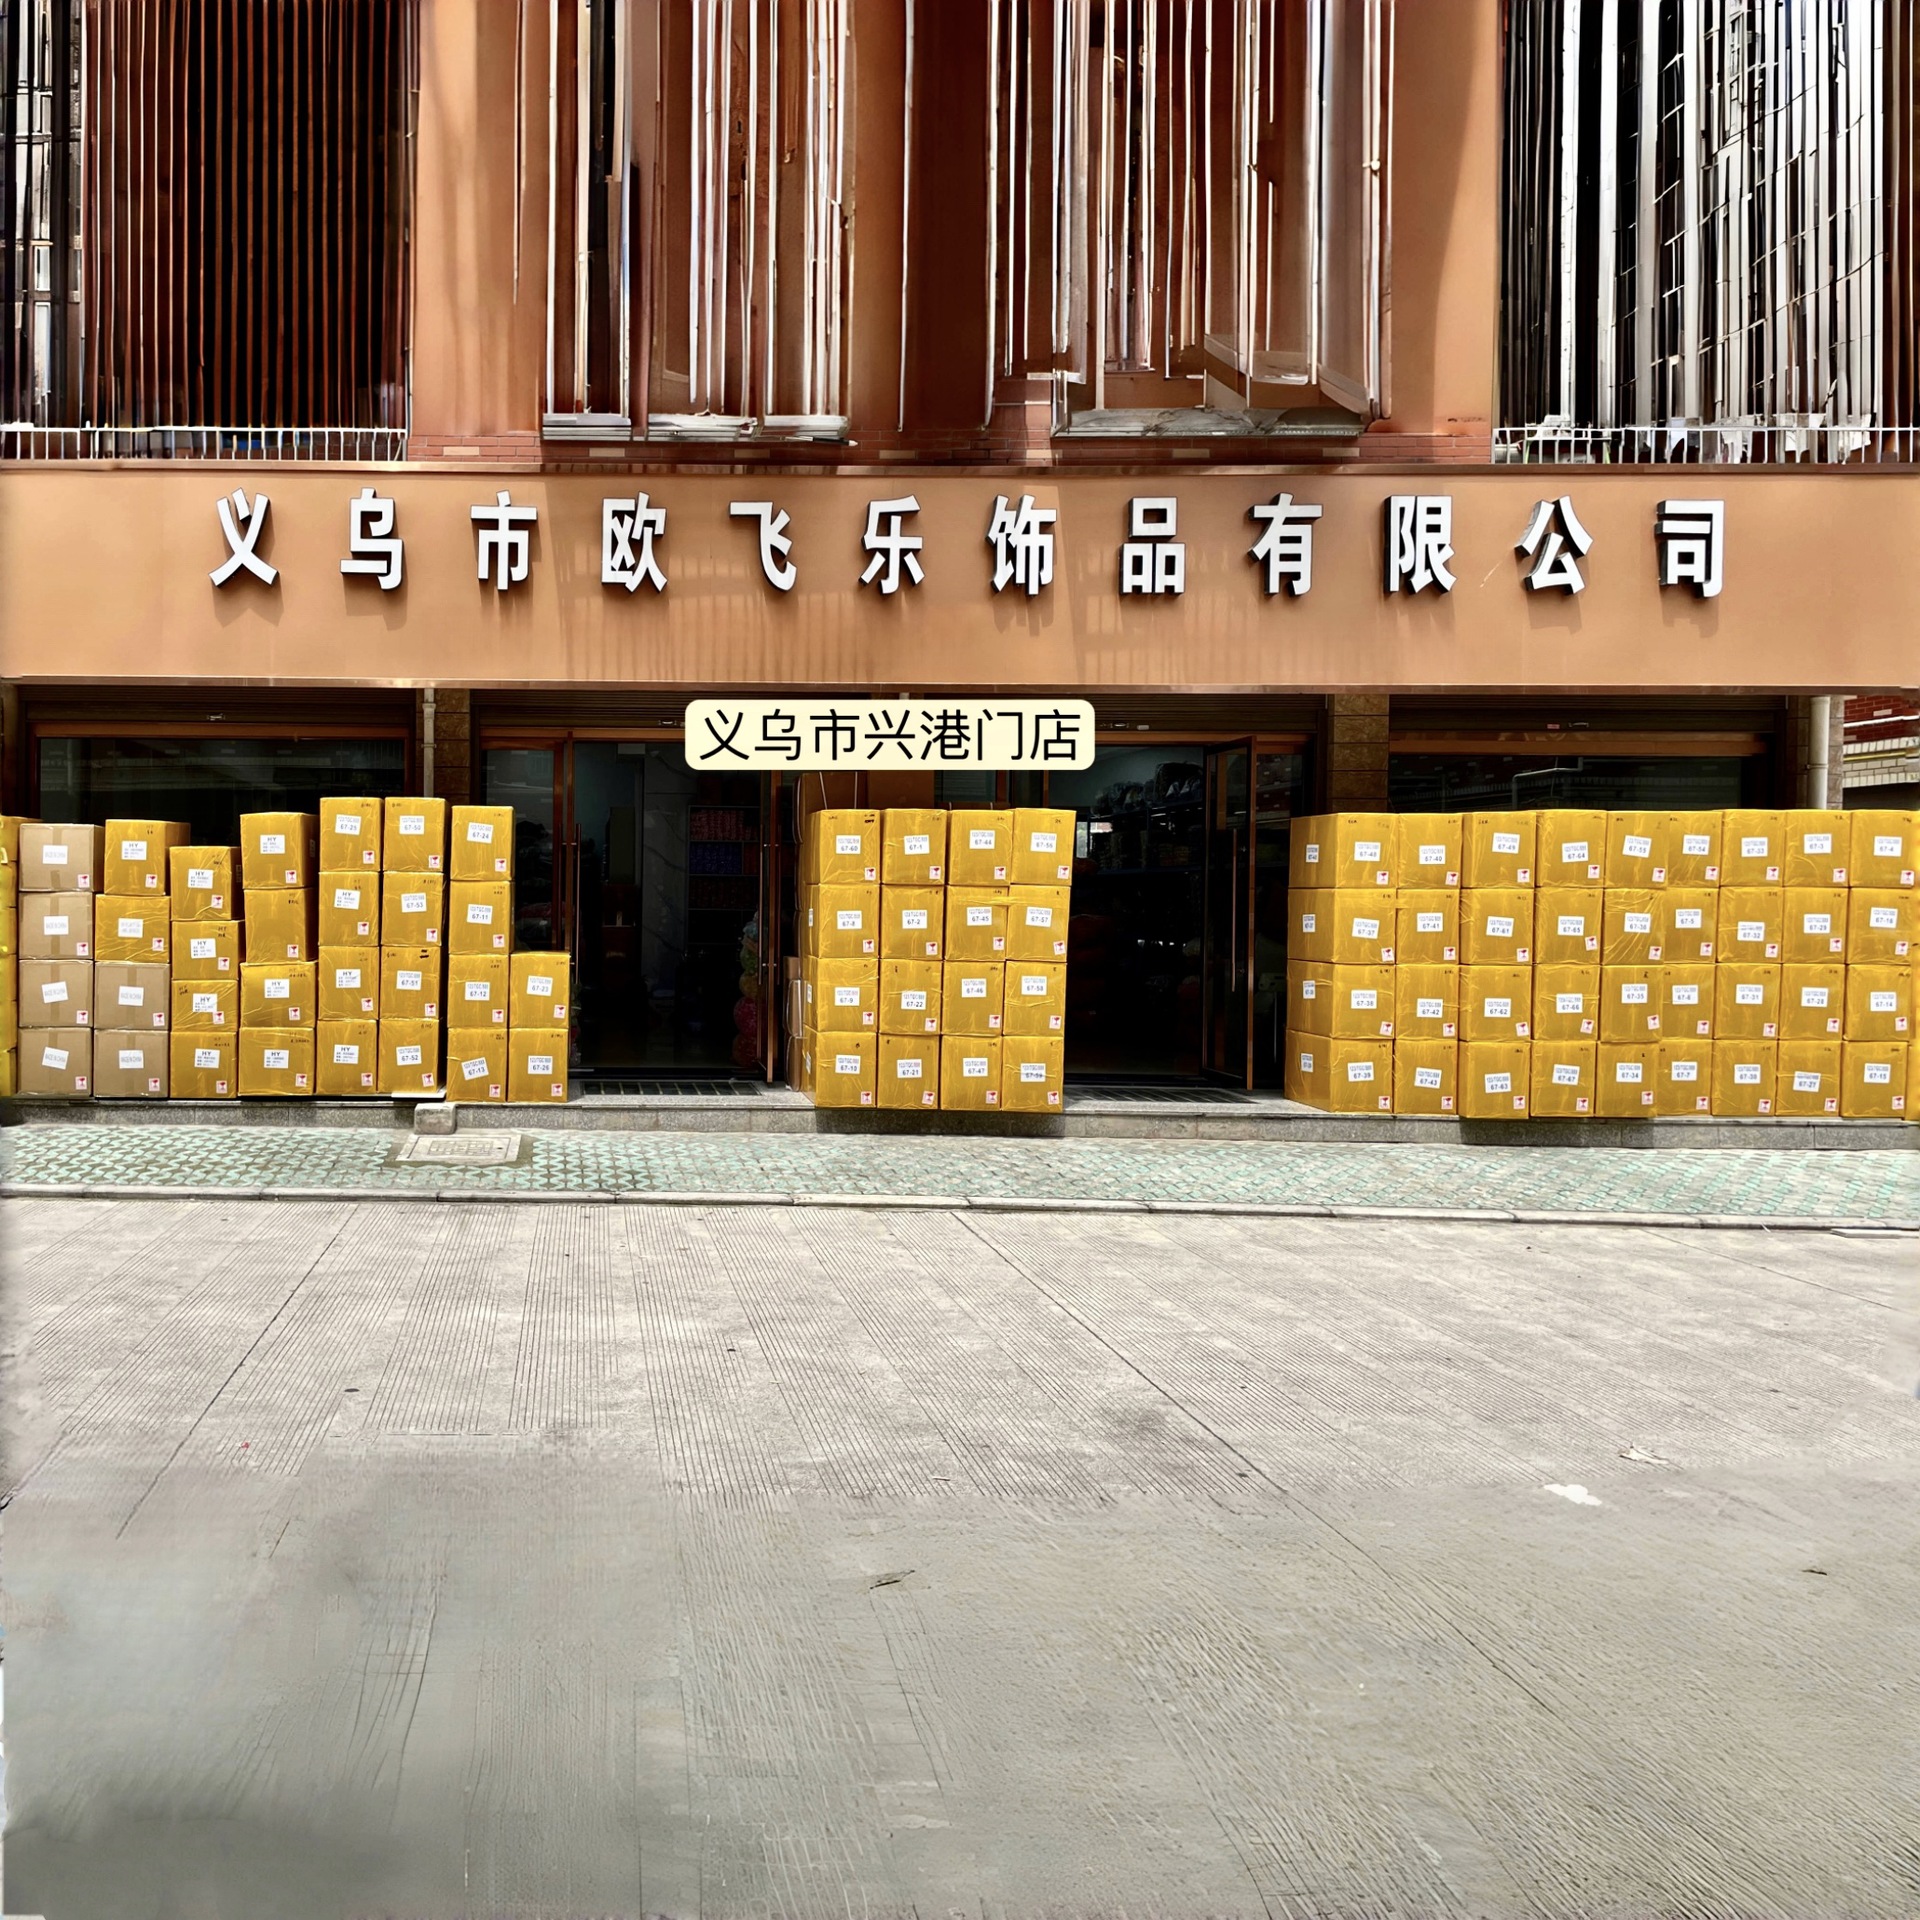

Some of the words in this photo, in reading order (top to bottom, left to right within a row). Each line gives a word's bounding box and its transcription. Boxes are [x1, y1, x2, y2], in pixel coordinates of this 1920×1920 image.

[209, 488, 1724, 597] 义乌市欧飞乐饰品有限公司
